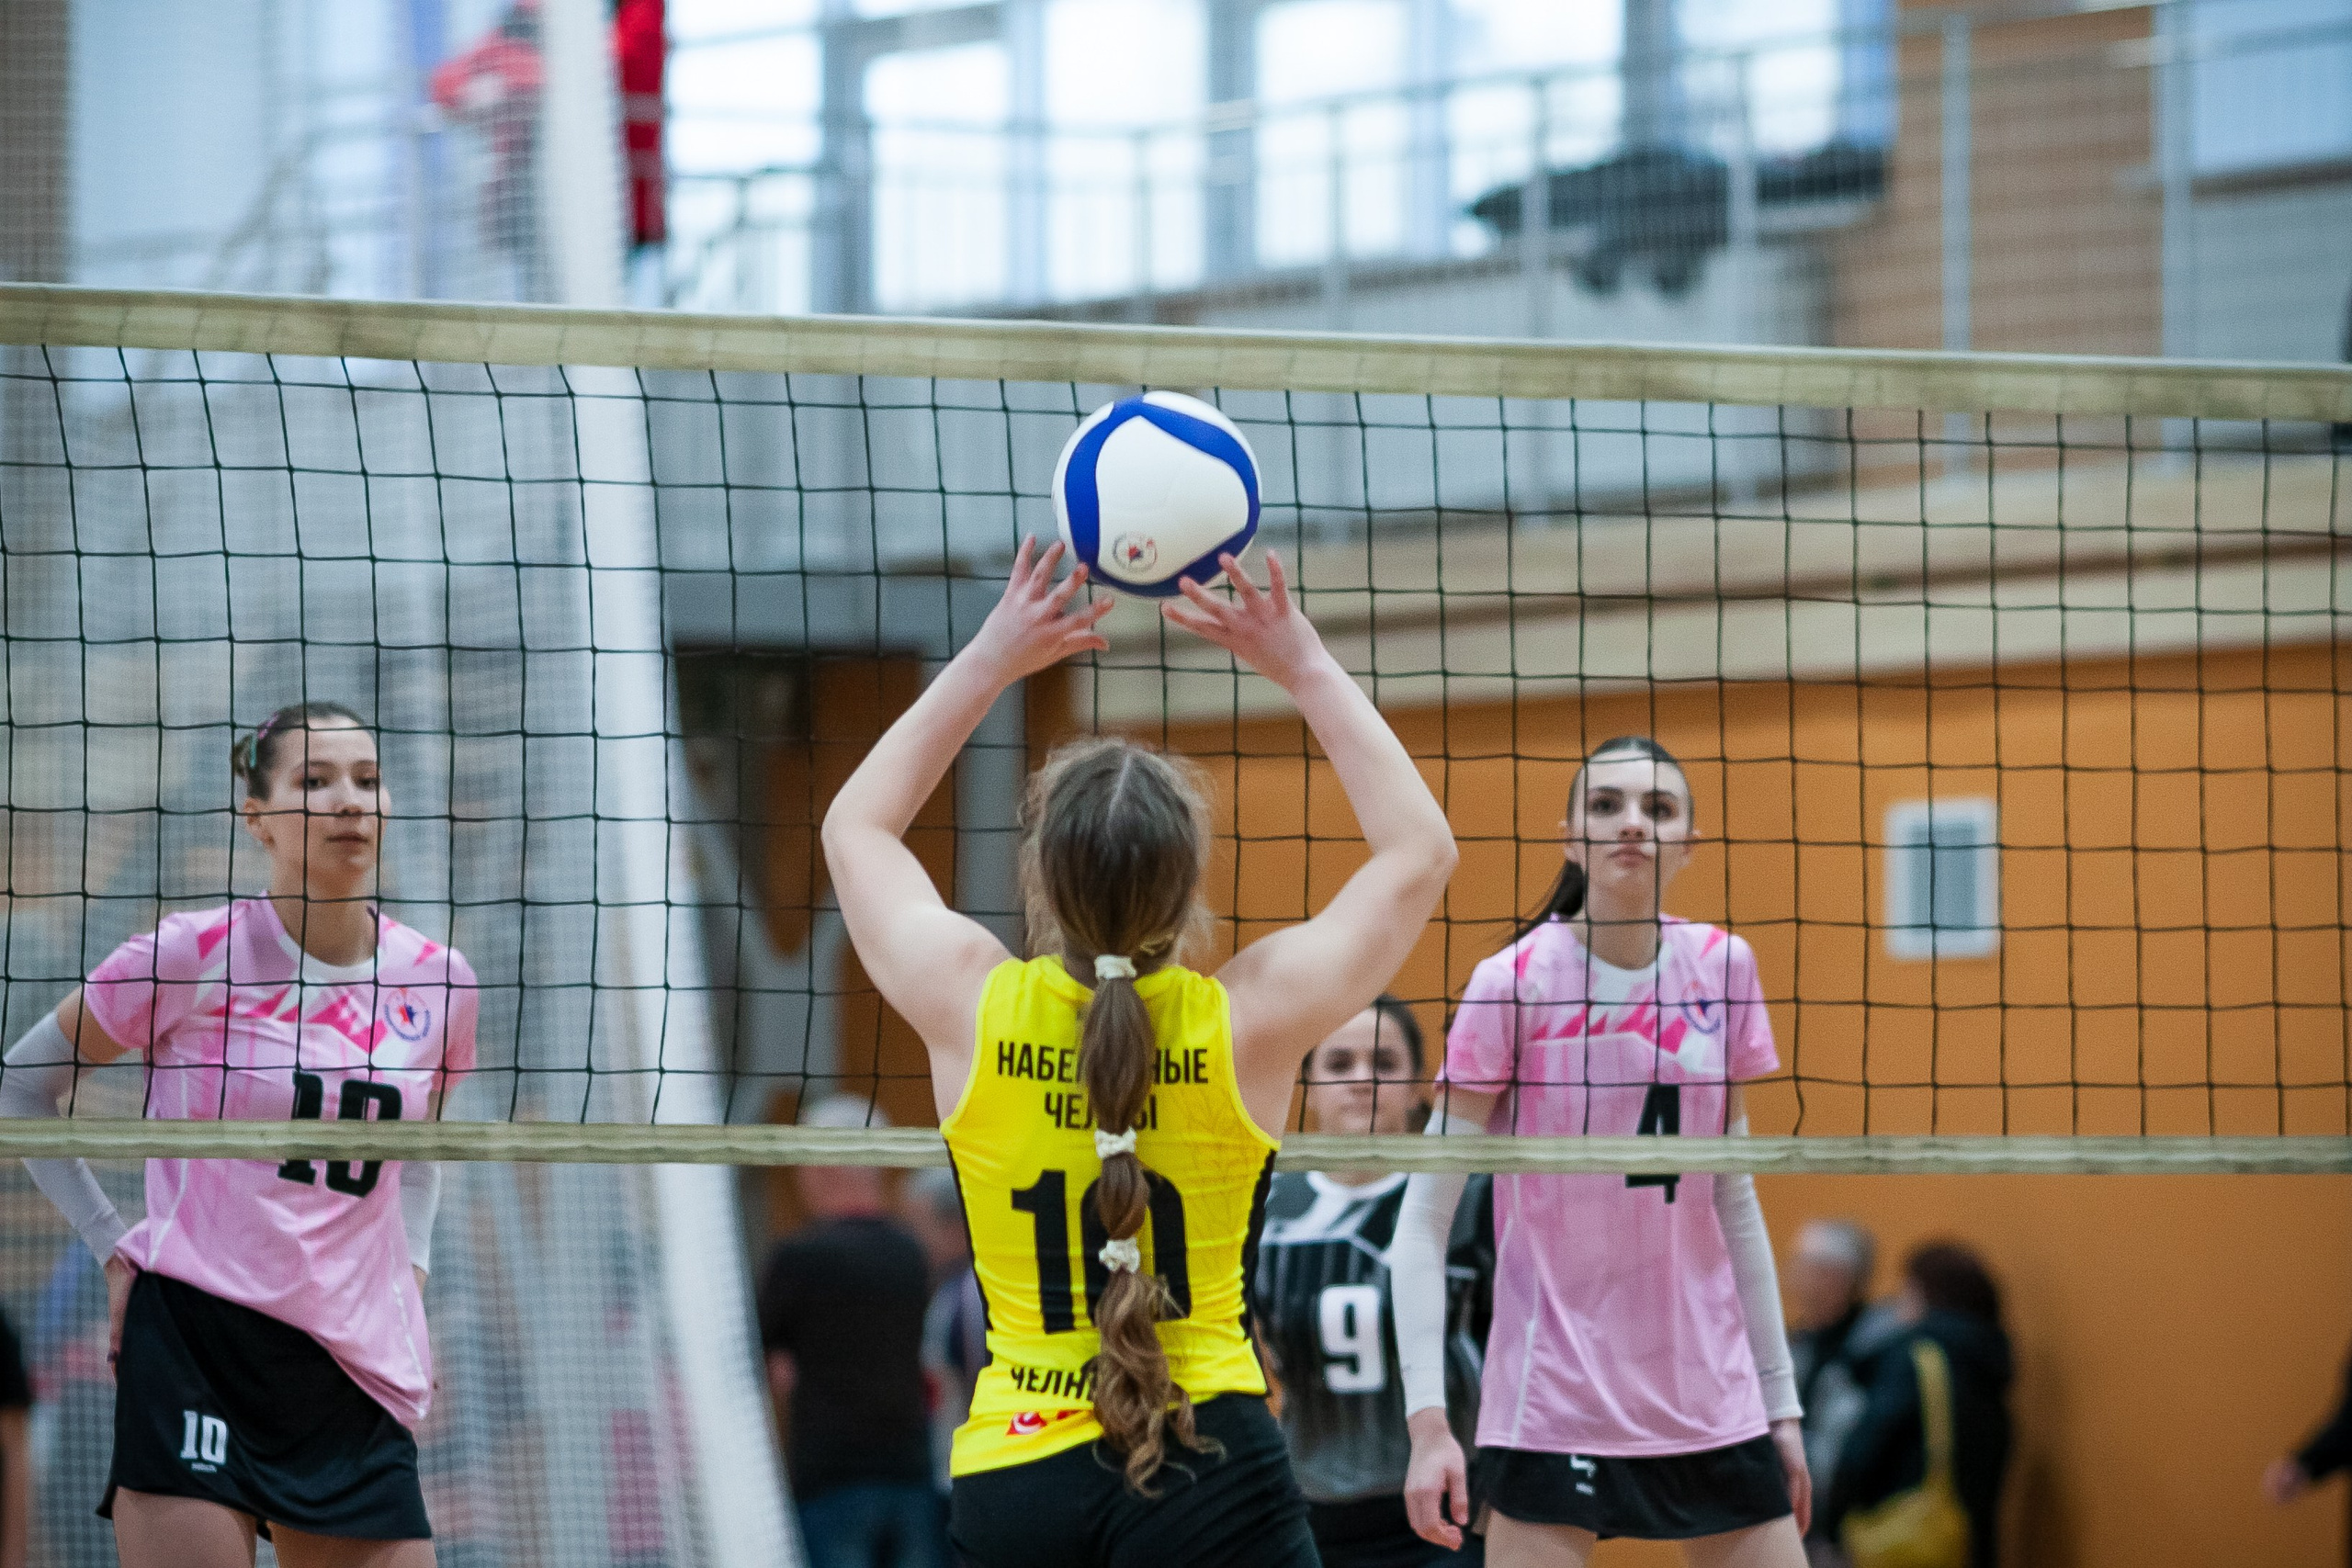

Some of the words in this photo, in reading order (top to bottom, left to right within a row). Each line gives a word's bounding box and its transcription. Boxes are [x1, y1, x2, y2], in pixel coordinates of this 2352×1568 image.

[997, 1040, 1209, 1085] НАБЕЫЕ
[1045, 1090, 1158, 1131] ЧЕЫ
[277, 1071, 402, 1199] 10
[1624, 1083, 1680, 1204] 4
[1011, 1169, 1193, 1336] 10
[1320, 1285, 1385, 1393] 9
[180, 1409, 229, 1466] 10
